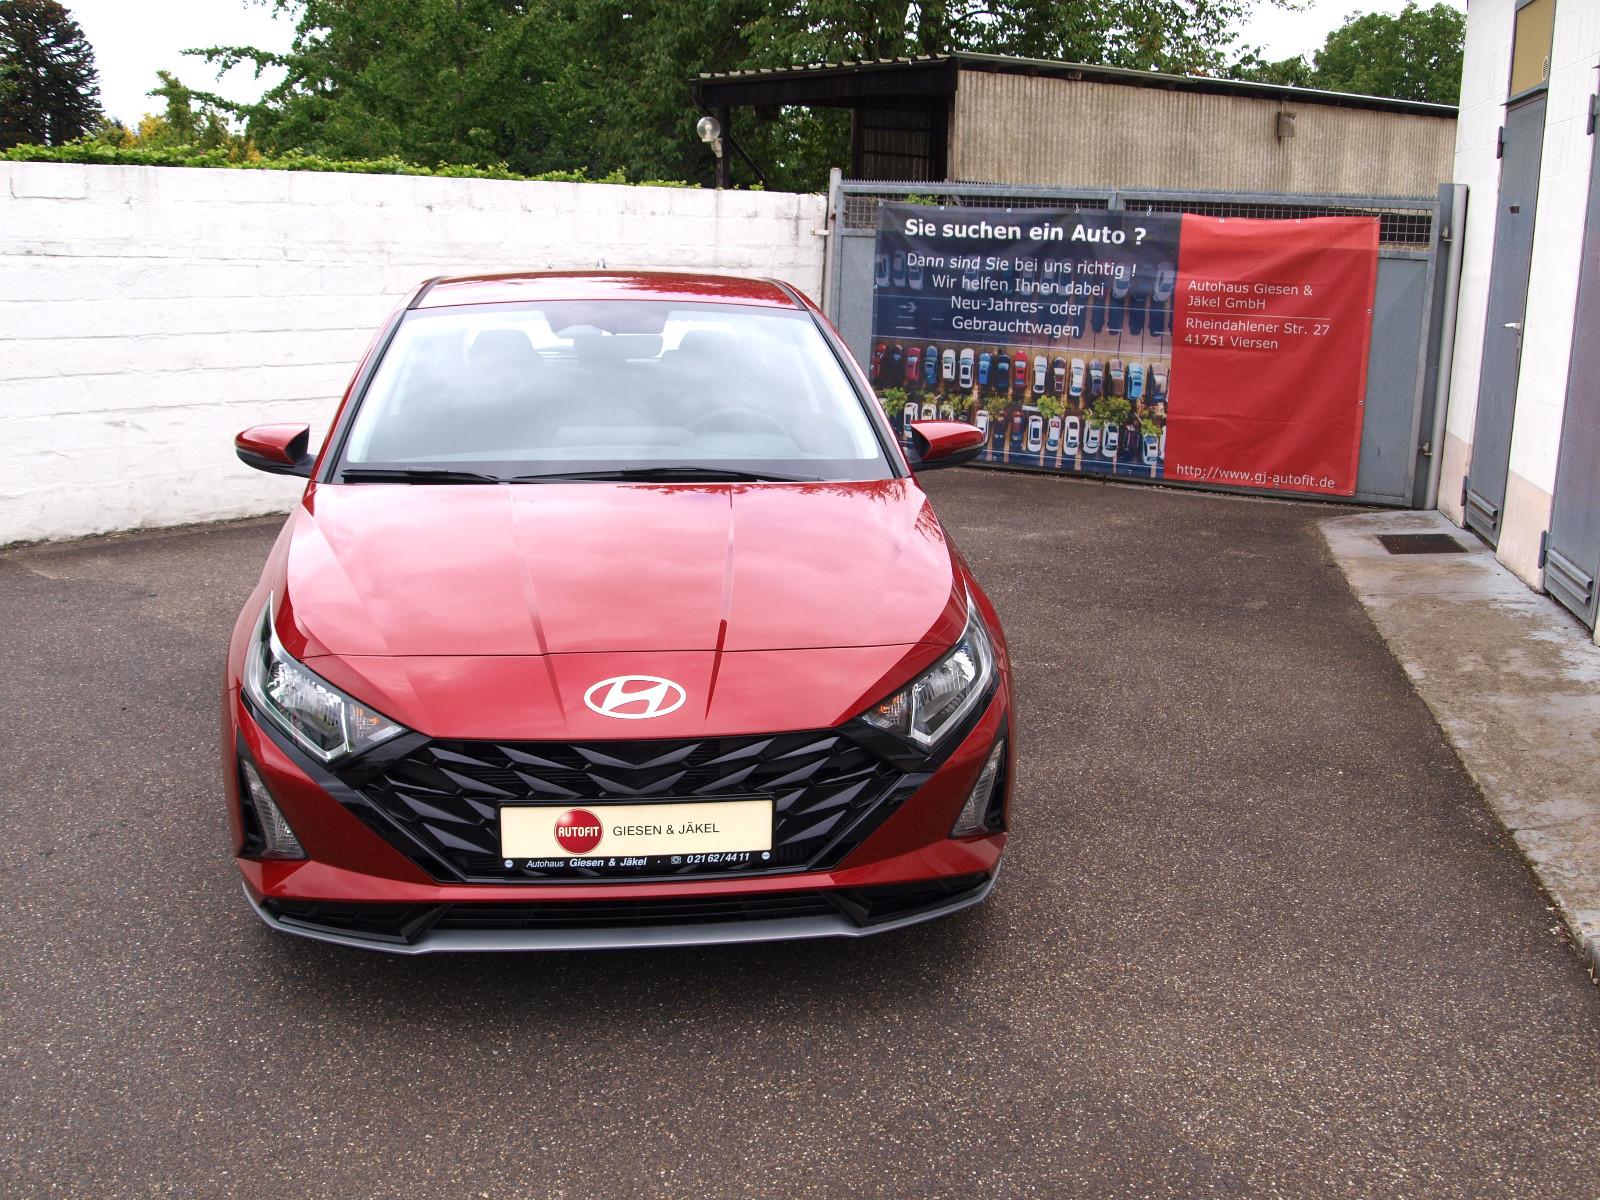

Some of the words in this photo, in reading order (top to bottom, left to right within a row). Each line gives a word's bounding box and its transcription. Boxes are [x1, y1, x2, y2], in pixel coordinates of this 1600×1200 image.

[904, 218, 936, 237] Sie
[942, 221, 1021, 240] suchen
[1029, 223, 1063, 241] ein
[1071, 224, 1126, 245] Auto
[1134, 227, 1147, 246] ?
[907, 253, 944, 268] Dann
[949, 256, 980, 270] sind
[985, 256, 1009, 271] Sie
[1015, 259, 1038, 273] bei
[1044, 262, 1072, 274] uns
[1077, 261, 1125, 279] richtig
[1130, 264, 1137, 277] !
[932, 274, 957, 289] Wir
[962, 276, 1009, 292] helfen
[1014, 277, 1060, 294] Ihnen
[1065, 281, 1105, 297] dabei
[1188, 280, 1249, 293] Autohaus
[1254, 284, 1299, 296] Giesen
[1303, 285, 1313, 296] &
[951, 296, 1044, 313] Neu-Jahres-
[1049, 301, 1084, 316] oder
[1187, 295, 1220, 308] Jäkel
[1225, 297, 1266, 310] GmbH
[952, 316, 1080, 337] Gebrauchtwagen
[1186, 317, 1279, 334] Rheindahlener
[1284, 322, 1308, 335] Str.
[1313, 324, 1330, 336] 27
[1184, 333, 1225, 347] 41751
[1230, 336, 1279, 350] Viersen
[1176, 463, 1335, 488] http://www.gj-autofit.de
[558, 826, 600, 838] AUTOFIT
[612, 825, 663, 837] GIESEN
[666, 825, 675, 836] &
[678, 822, 720, 835] JÄKEL
[526, 859, 565, 868] Autohaus
[569, 858, 604, 868] Giesen
[608, 859, 617, 867] &
[620, 857, 647, 867] Jäkel
